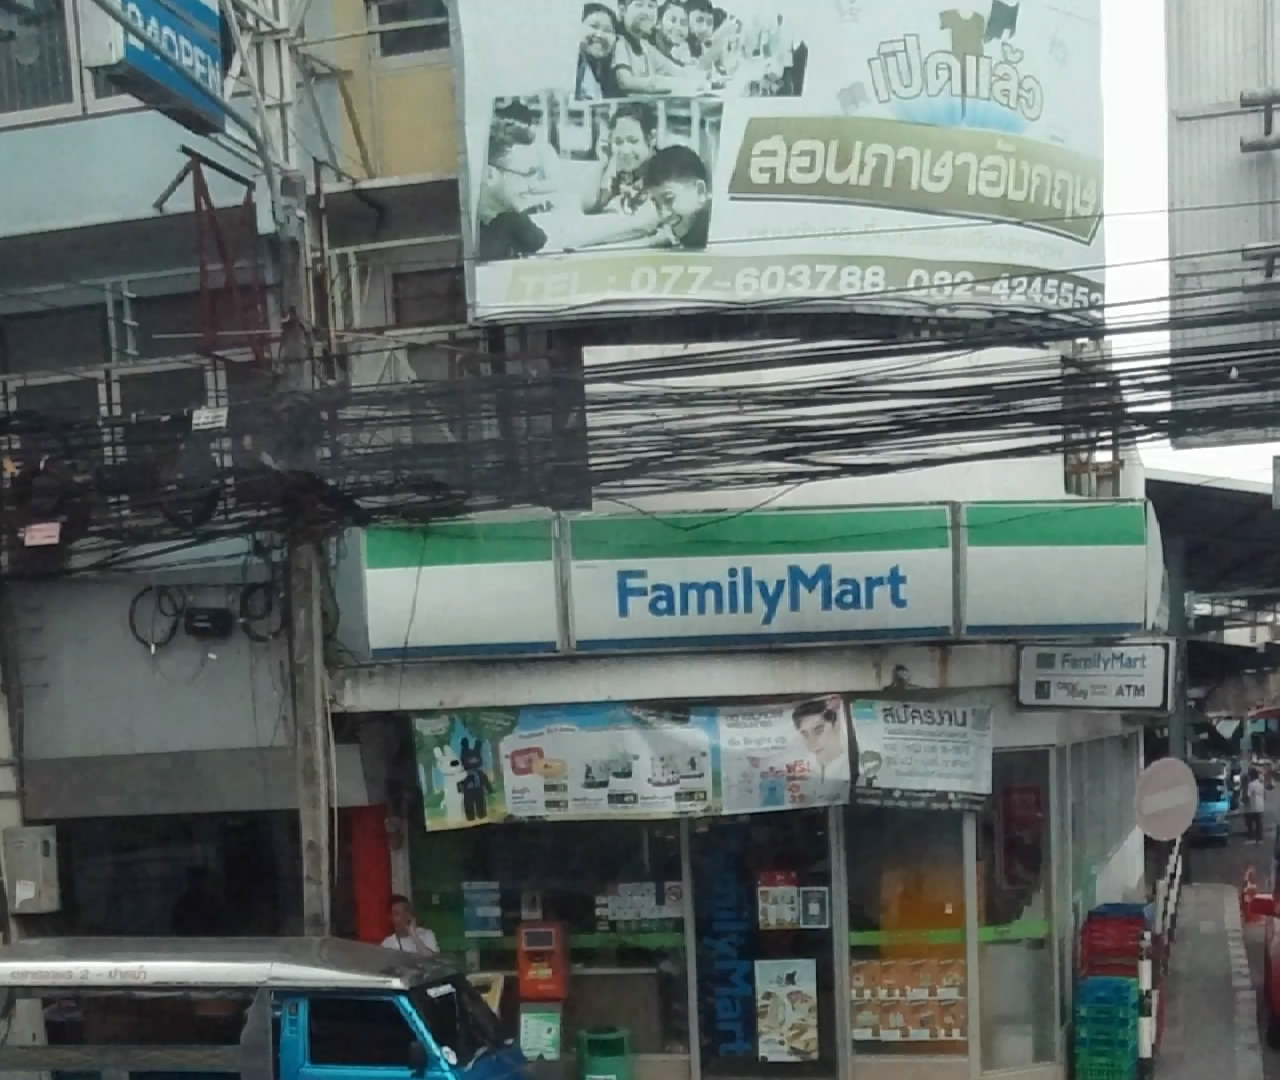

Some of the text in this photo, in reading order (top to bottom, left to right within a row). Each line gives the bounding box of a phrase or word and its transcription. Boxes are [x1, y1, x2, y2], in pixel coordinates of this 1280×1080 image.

[867, 29, 1044, 122] เปิดแล้ว
[748, 134, 1099, 223] สอนภาษาอังกฤษ
[616, 563, 909, 626] FamilyMart
[1060, 651, 1147, 671] FamilyMart
[1115, 683, 1146, 698] ATM
[881, 703, 969, 728] สมัครงาน
